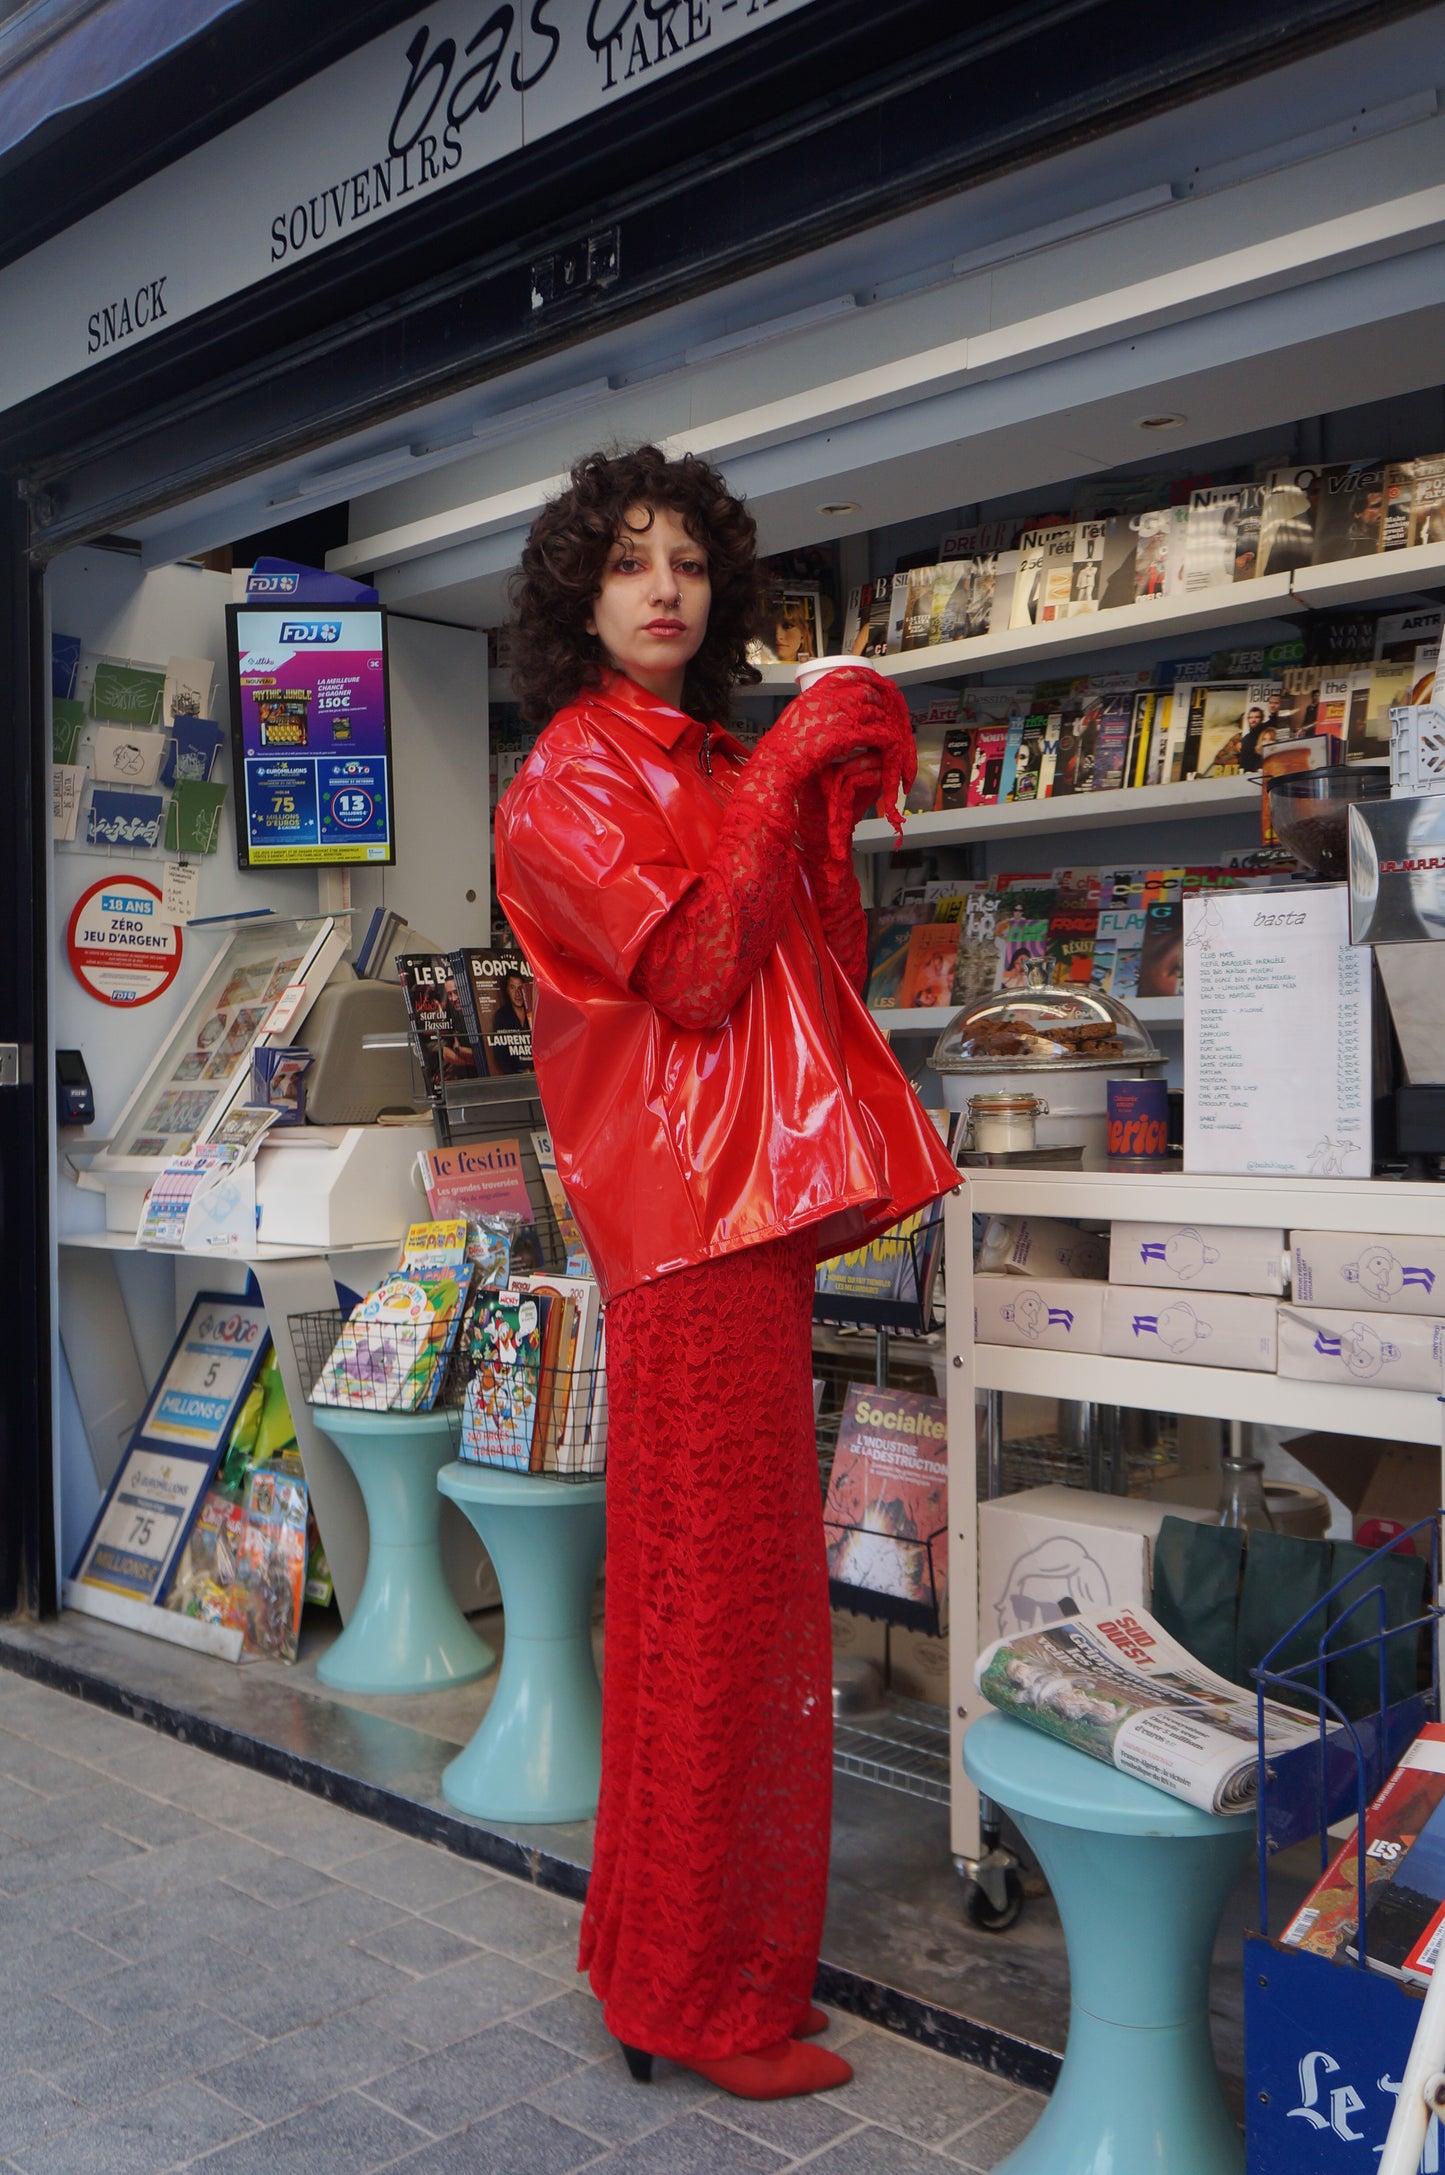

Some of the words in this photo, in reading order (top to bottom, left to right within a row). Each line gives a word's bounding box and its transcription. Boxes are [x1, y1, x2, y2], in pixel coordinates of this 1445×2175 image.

[271, 123, 463, 263] SOUVENIRS
[88, 277, 168, 355] SNACK
[249, 576, 278, 592] FDJ
[283, 625, 319, 641] FDJ
[318, 684, 344, 692] CHANCE
[327, 676, 361, 684] MEILLEURE
[252, 689, 282, 702] MYTHIC
[283, 688, 313, 701] JUNGLE
[318, 697, 351, 709] 150€
[325, 690, 352, 698] GAGNER
[266, 767, 308, 775] EUROMILLIONS
[343, 765, 371, 775] LOTO
[271, 797, 295, 813] 75
[340, 795, 365, 812] 13
[103, 899, 123, 911] -18
[125, 900, 151, 914] ANS
[111, 917, 144, 932] ZÉRO
[1253, 911, 1307, 927] basta
[84, 930, 106, 943] JEU
[108, 933, 168, 948] D'ARGENT
[414, 967, 435, 985] LE
[420, 1011, 436, 1021] star
[487, 1034, 532, 1047] LAURENT
[433, 1155, 451, 1177] le
[458, 1147, 518, 1174] festin
[437, 1187, 451, 1197] Les
[451, 1182, 481, 1196] grandes
[482, 1178, 519, 1191] traversées
[213, 1314, 259, 1343] LOTO
[203, 1361, 221, 1388] 5
[161, 1396, 214, 1420] MILLIONS
[215, 1406, 226, 1421] €
[856, 1433, 919, 1457] L'INDUSTRIE
[850, 1443, 860, 1454] DE
[861, 1447, 873, 1457] LA
[872, 1449, 949, 1475] DESTRUCTION
[128, 1514, 156, 1546] 75
[96, 1550, 149, 1580] MILLIONS
[1114, 1616, 1157, 1648] SUD
[1096, 1621, 1157, 1669] OUEST
[1062, 1648, 1093, 1667] les
[1134, 1725, 1165, 1743] d'euros
[1141, 1719, 1163, 1732] lever
[1169, 1731, 1206, 1751] millions
[1366, 1838, 1402, 1860] LES
[1286, 2050, 1366, 2142] Le
